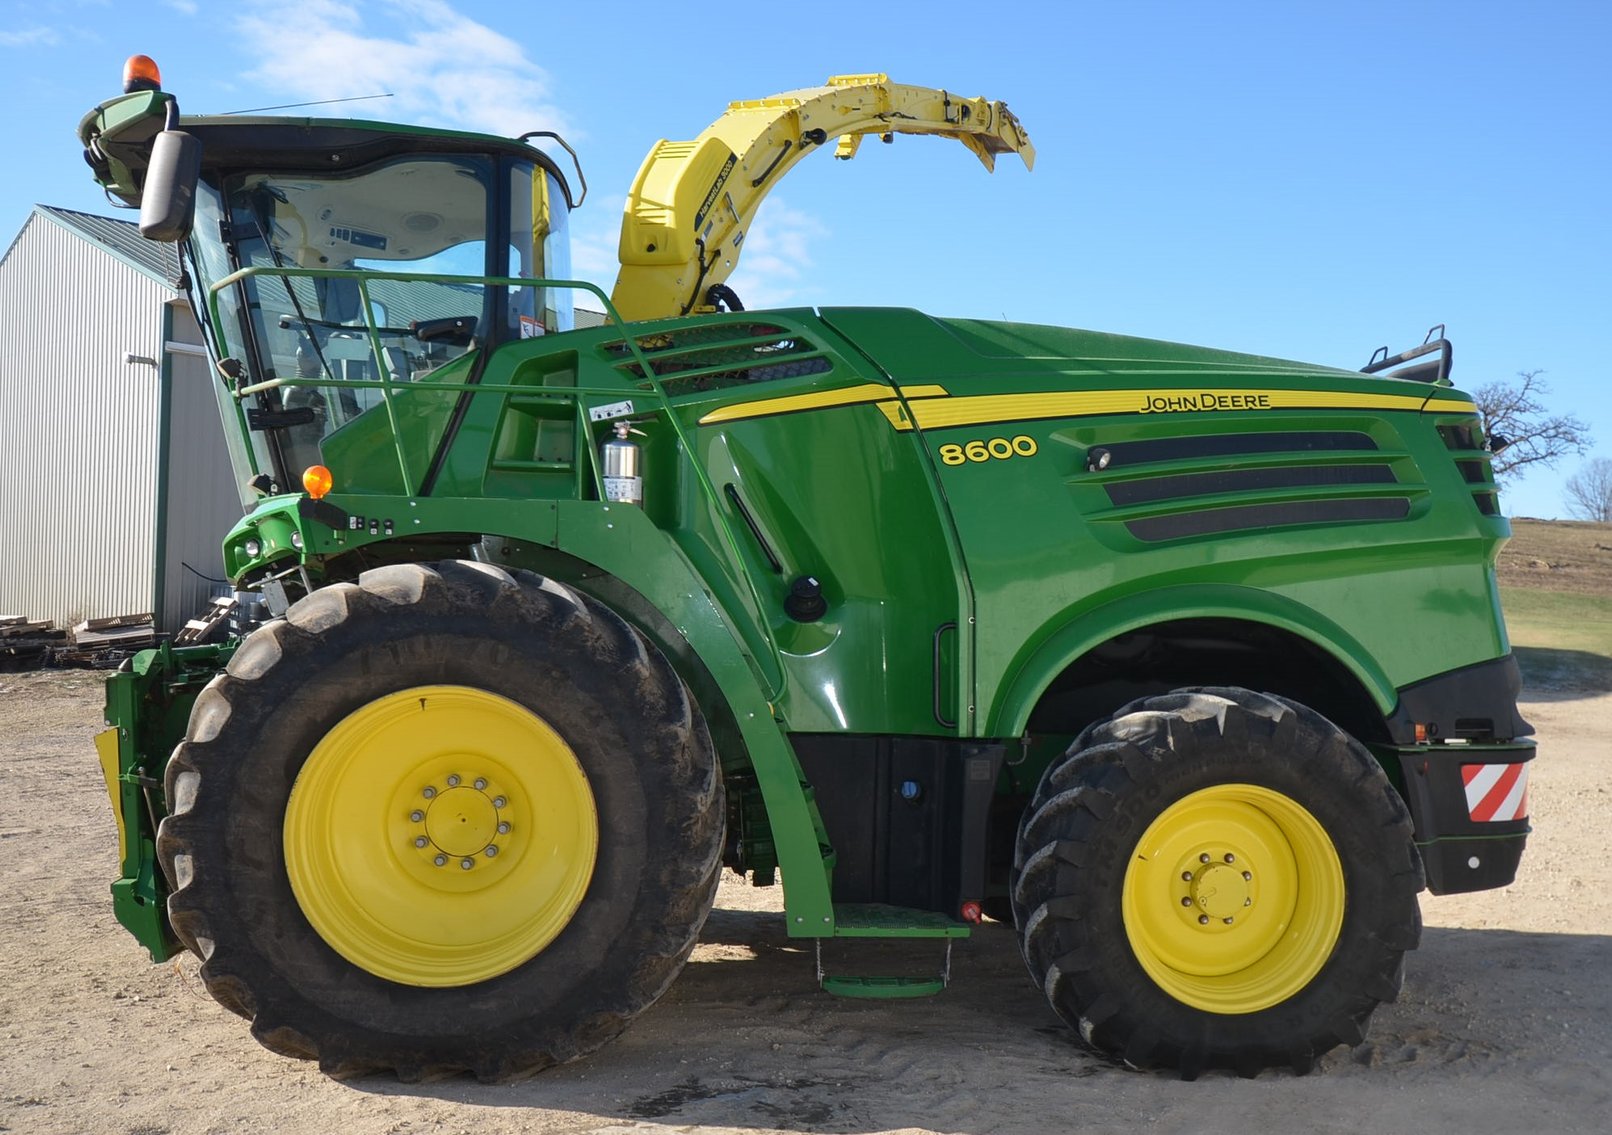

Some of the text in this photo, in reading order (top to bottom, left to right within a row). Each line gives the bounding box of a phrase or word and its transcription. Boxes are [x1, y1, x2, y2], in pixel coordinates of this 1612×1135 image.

[700, 178, 723, 218] HarvestLab
[1141, 393, 1270, 411] JOHN DEERE
[939, 435, 1038, 466] 8600
